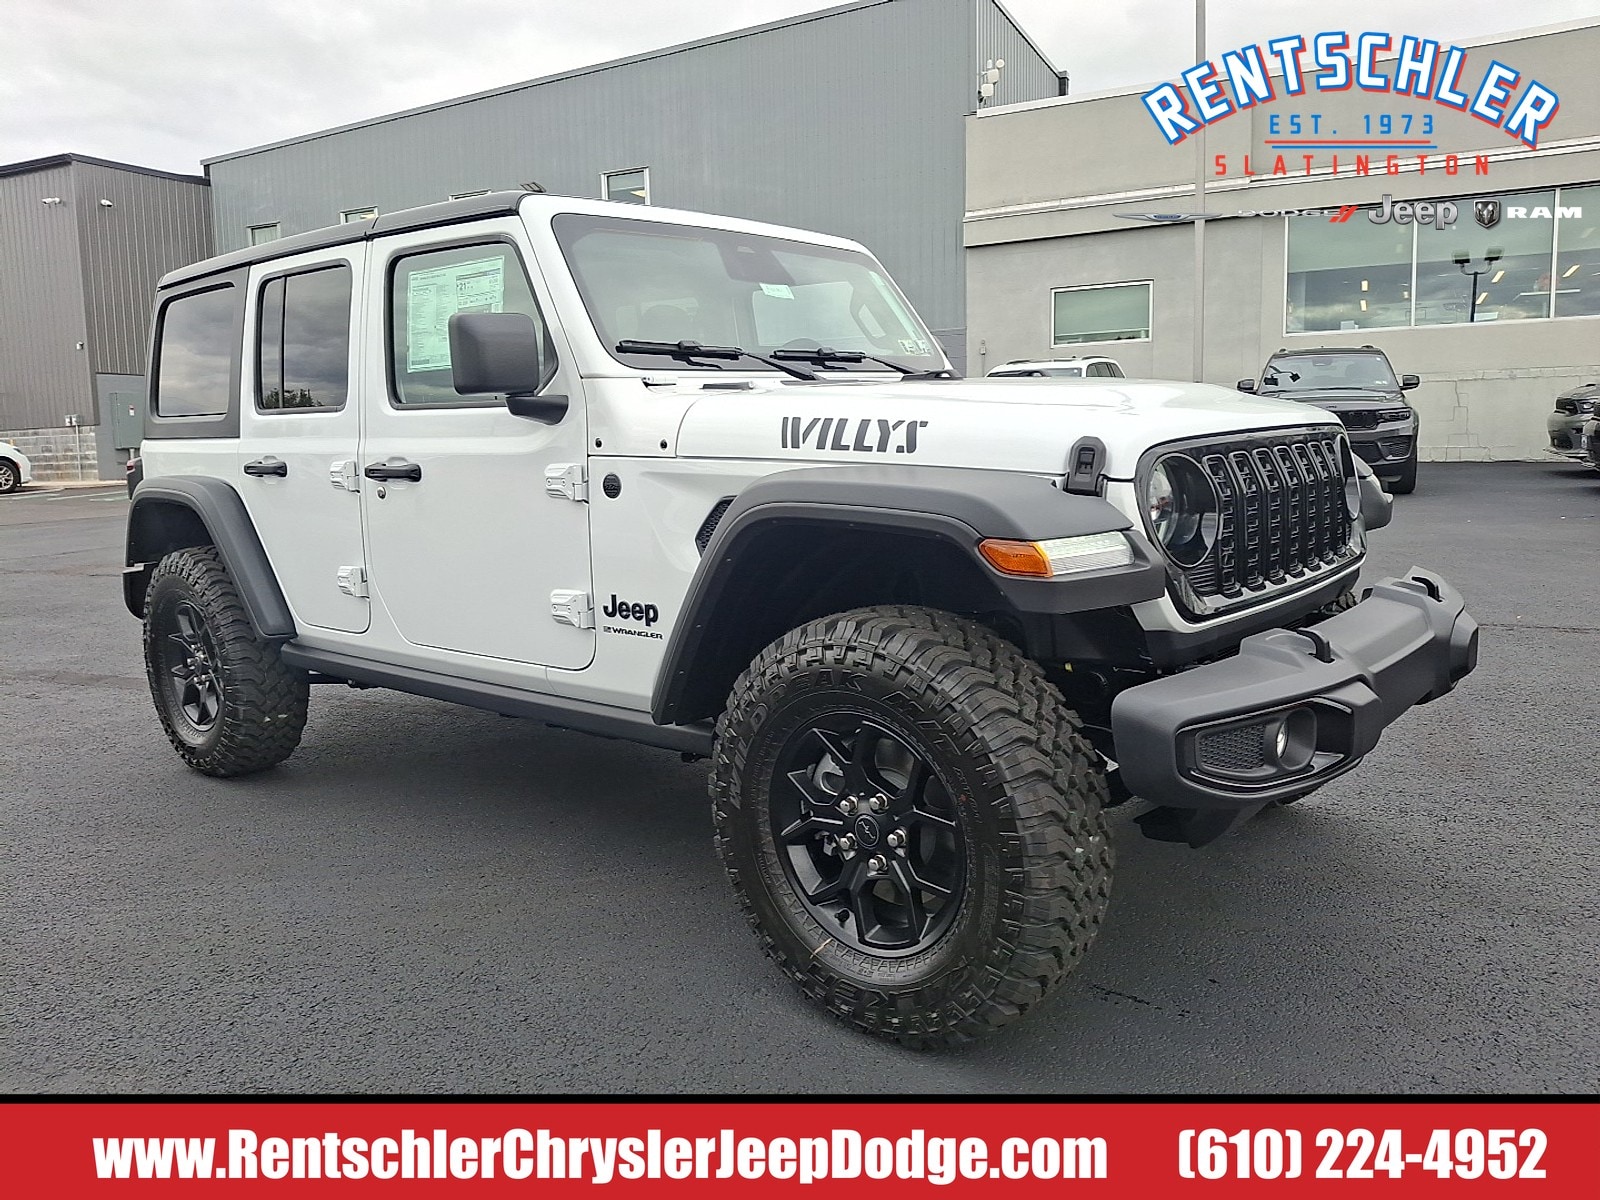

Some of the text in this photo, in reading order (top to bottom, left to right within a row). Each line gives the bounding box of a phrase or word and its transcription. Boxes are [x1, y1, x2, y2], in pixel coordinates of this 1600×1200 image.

[781, 416, 929, 454] WILLYS
[603, 594, 659, 627] Jeep
[612, 626, 663, 640] WRANGLER
